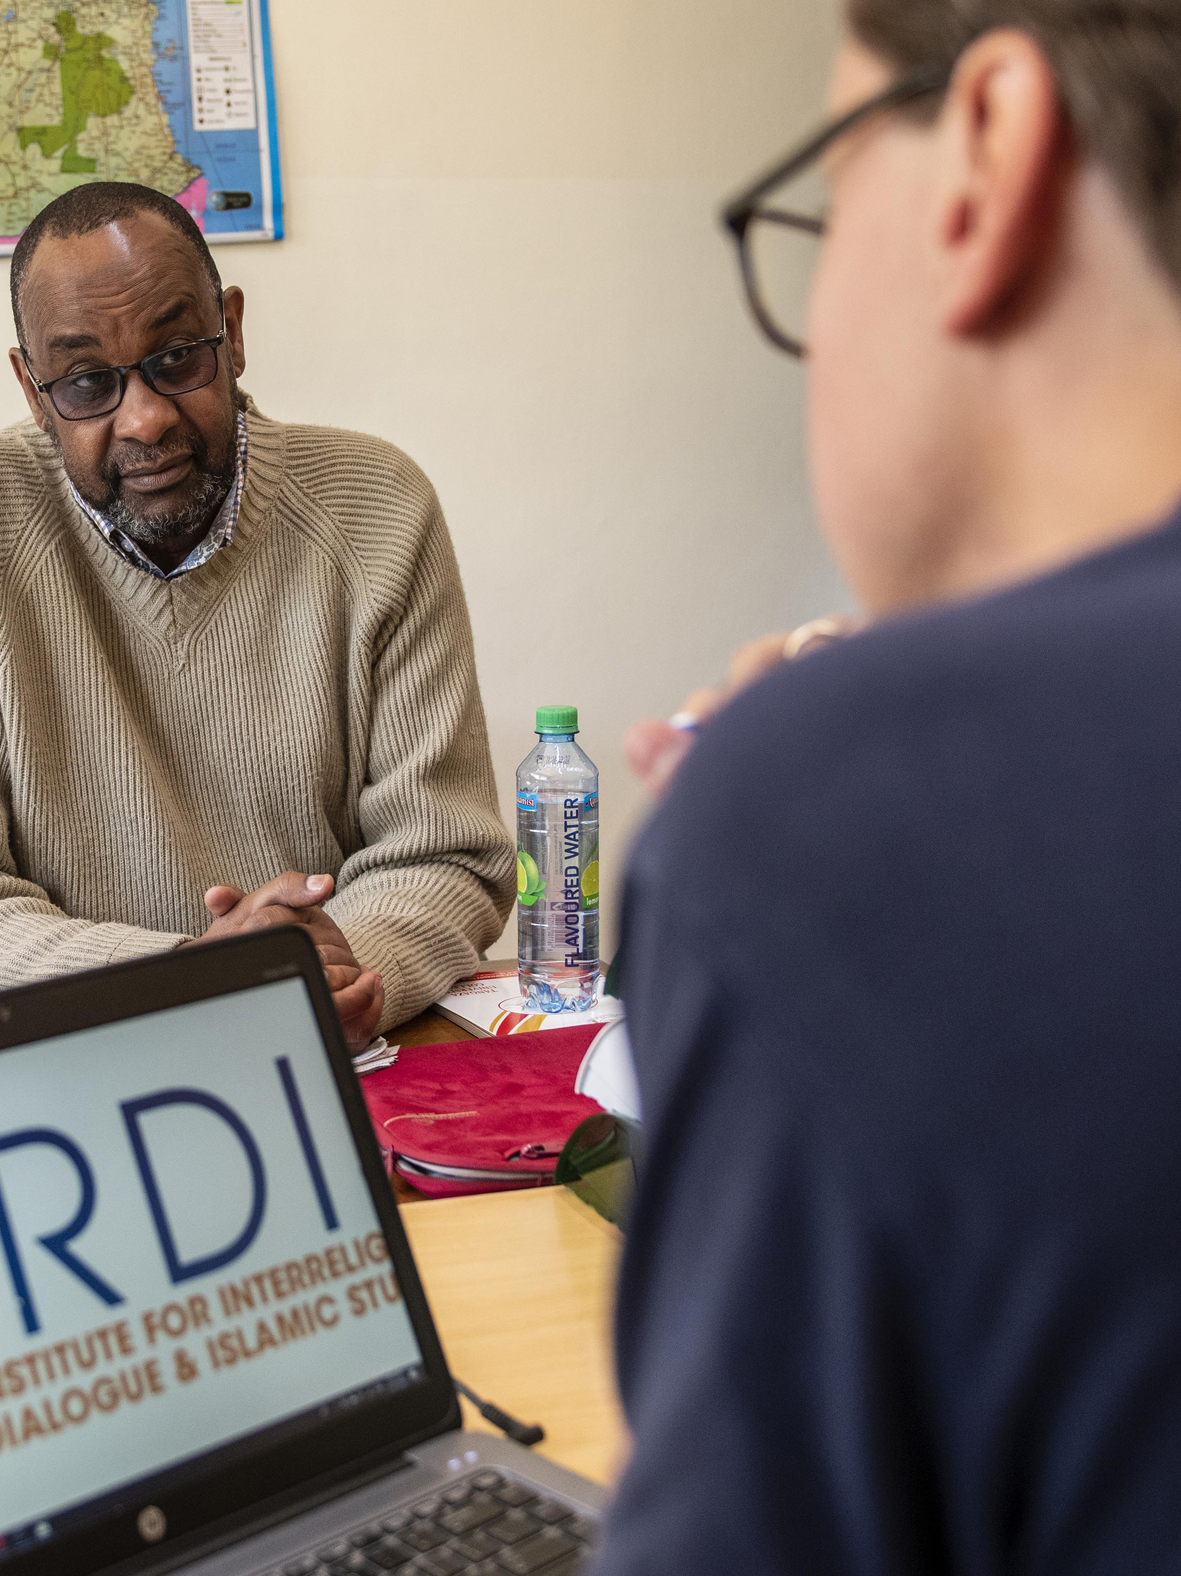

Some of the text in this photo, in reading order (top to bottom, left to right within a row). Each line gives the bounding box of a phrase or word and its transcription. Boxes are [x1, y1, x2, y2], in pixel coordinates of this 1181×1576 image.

[563, 797, 580, 968] FLAVOURED WATER
[141, 1293, 213, 1347] FOR
[173, 1348, 199, 1384] &
[206, 1296, 340, 1371] ISLAMIC
